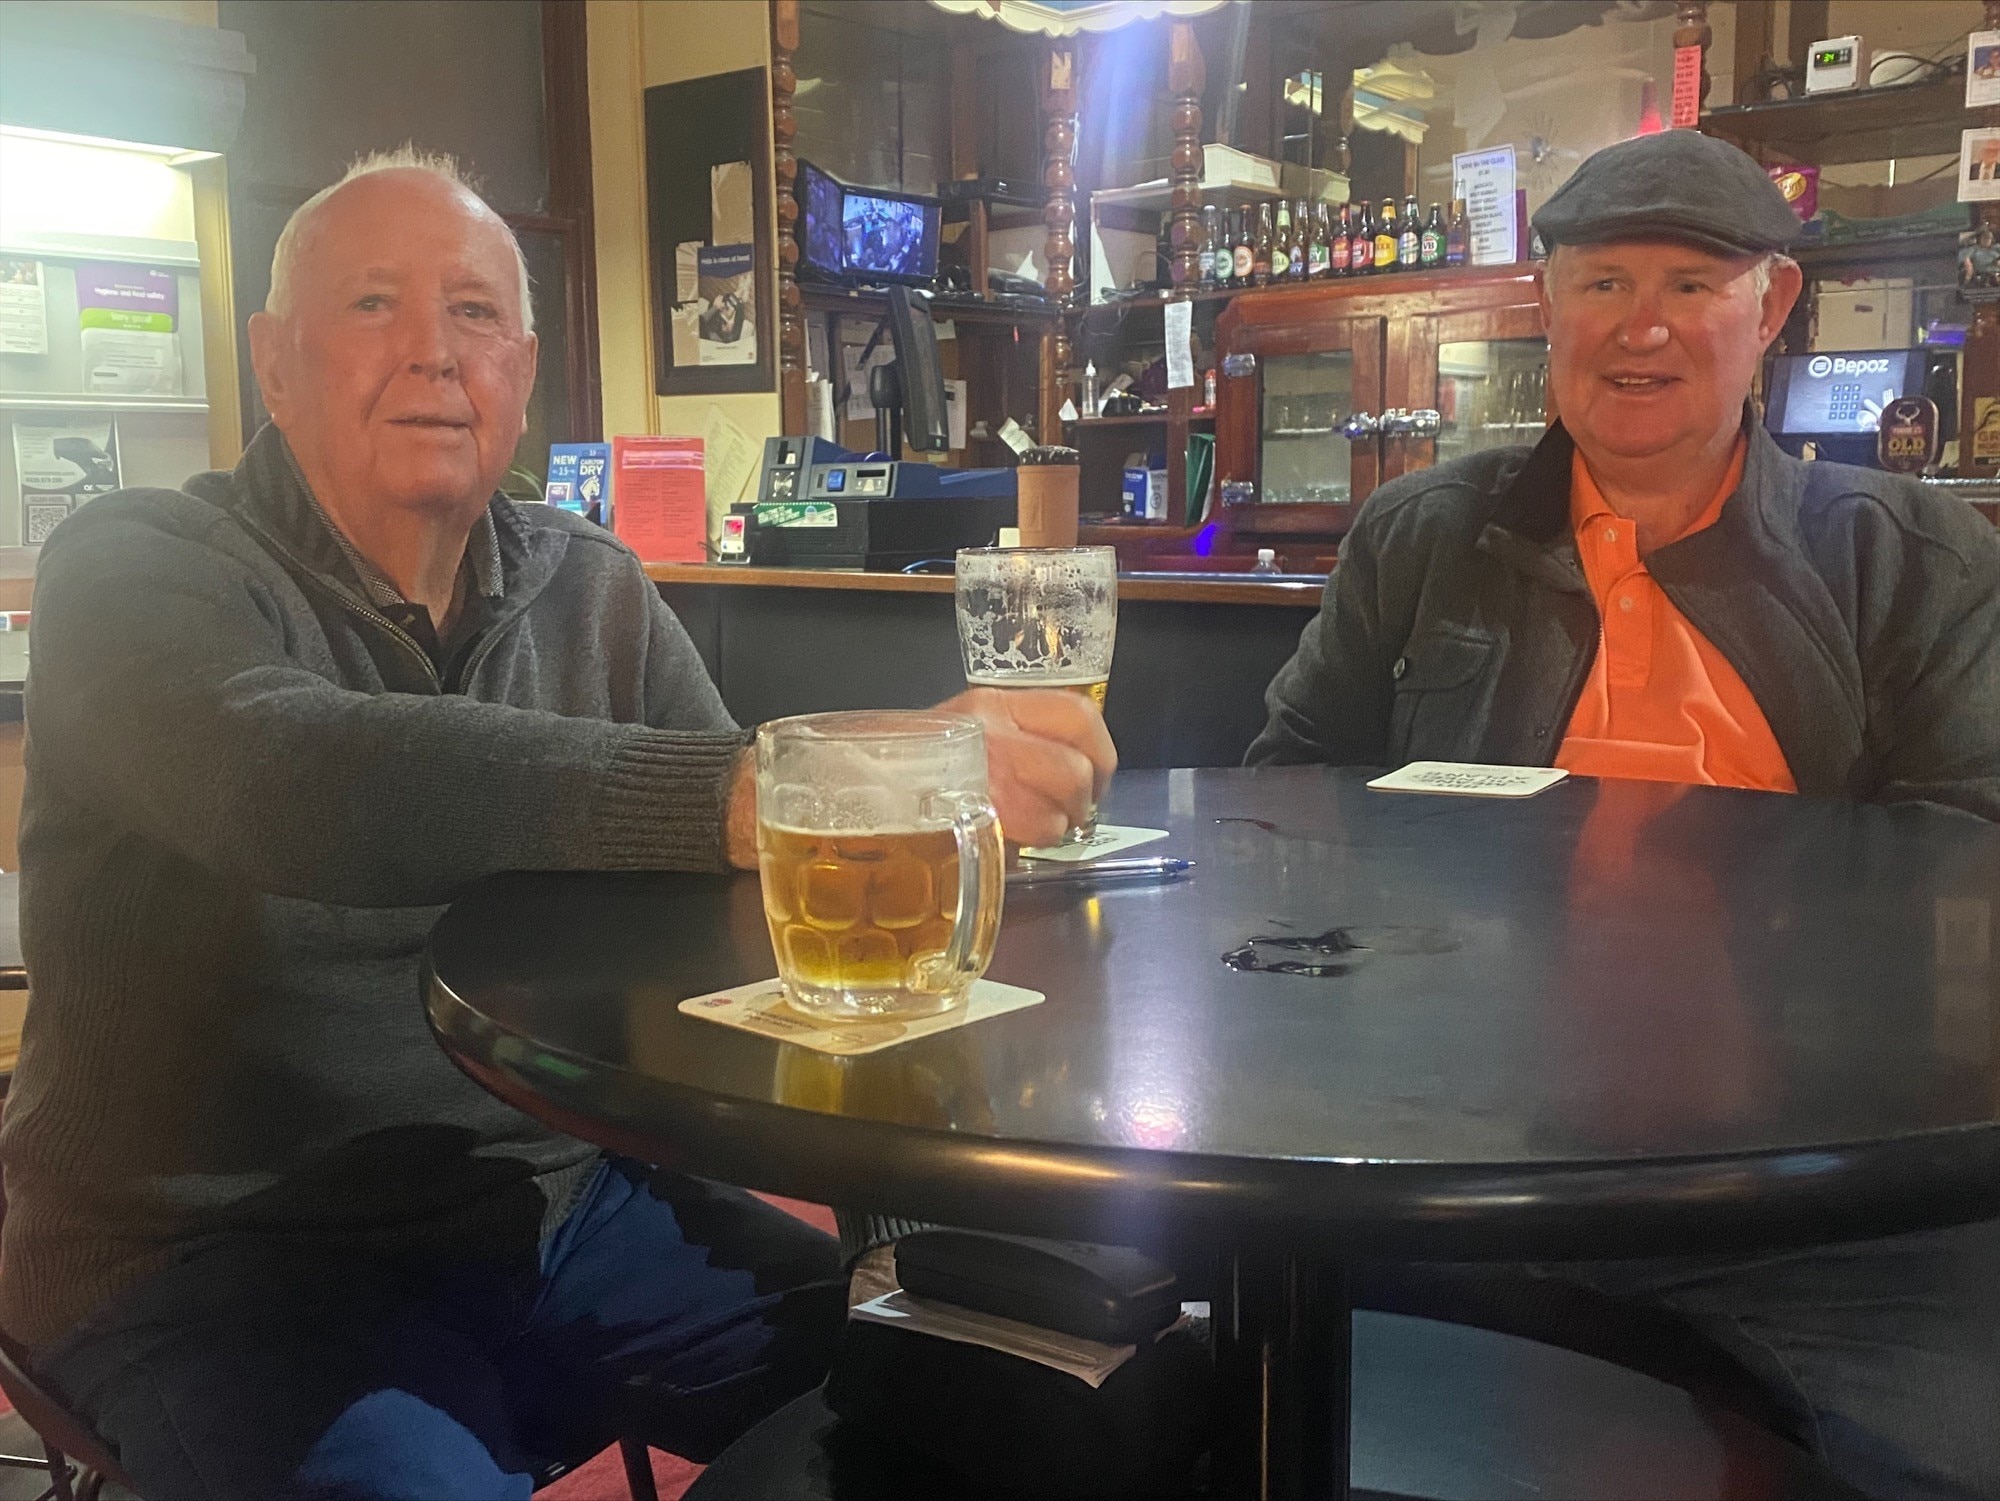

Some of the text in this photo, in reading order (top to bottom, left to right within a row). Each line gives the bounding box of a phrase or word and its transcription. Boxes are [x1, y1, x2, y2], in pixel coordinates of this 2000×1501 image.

[1423, 241, 1435, 250] VB
[1833, 357, 1889, 377] Bepoz
[1888, 438, 1926, 451] OLD
[553, 455, 577, 465] NEW
[579, 465, 603, 476] DRY
